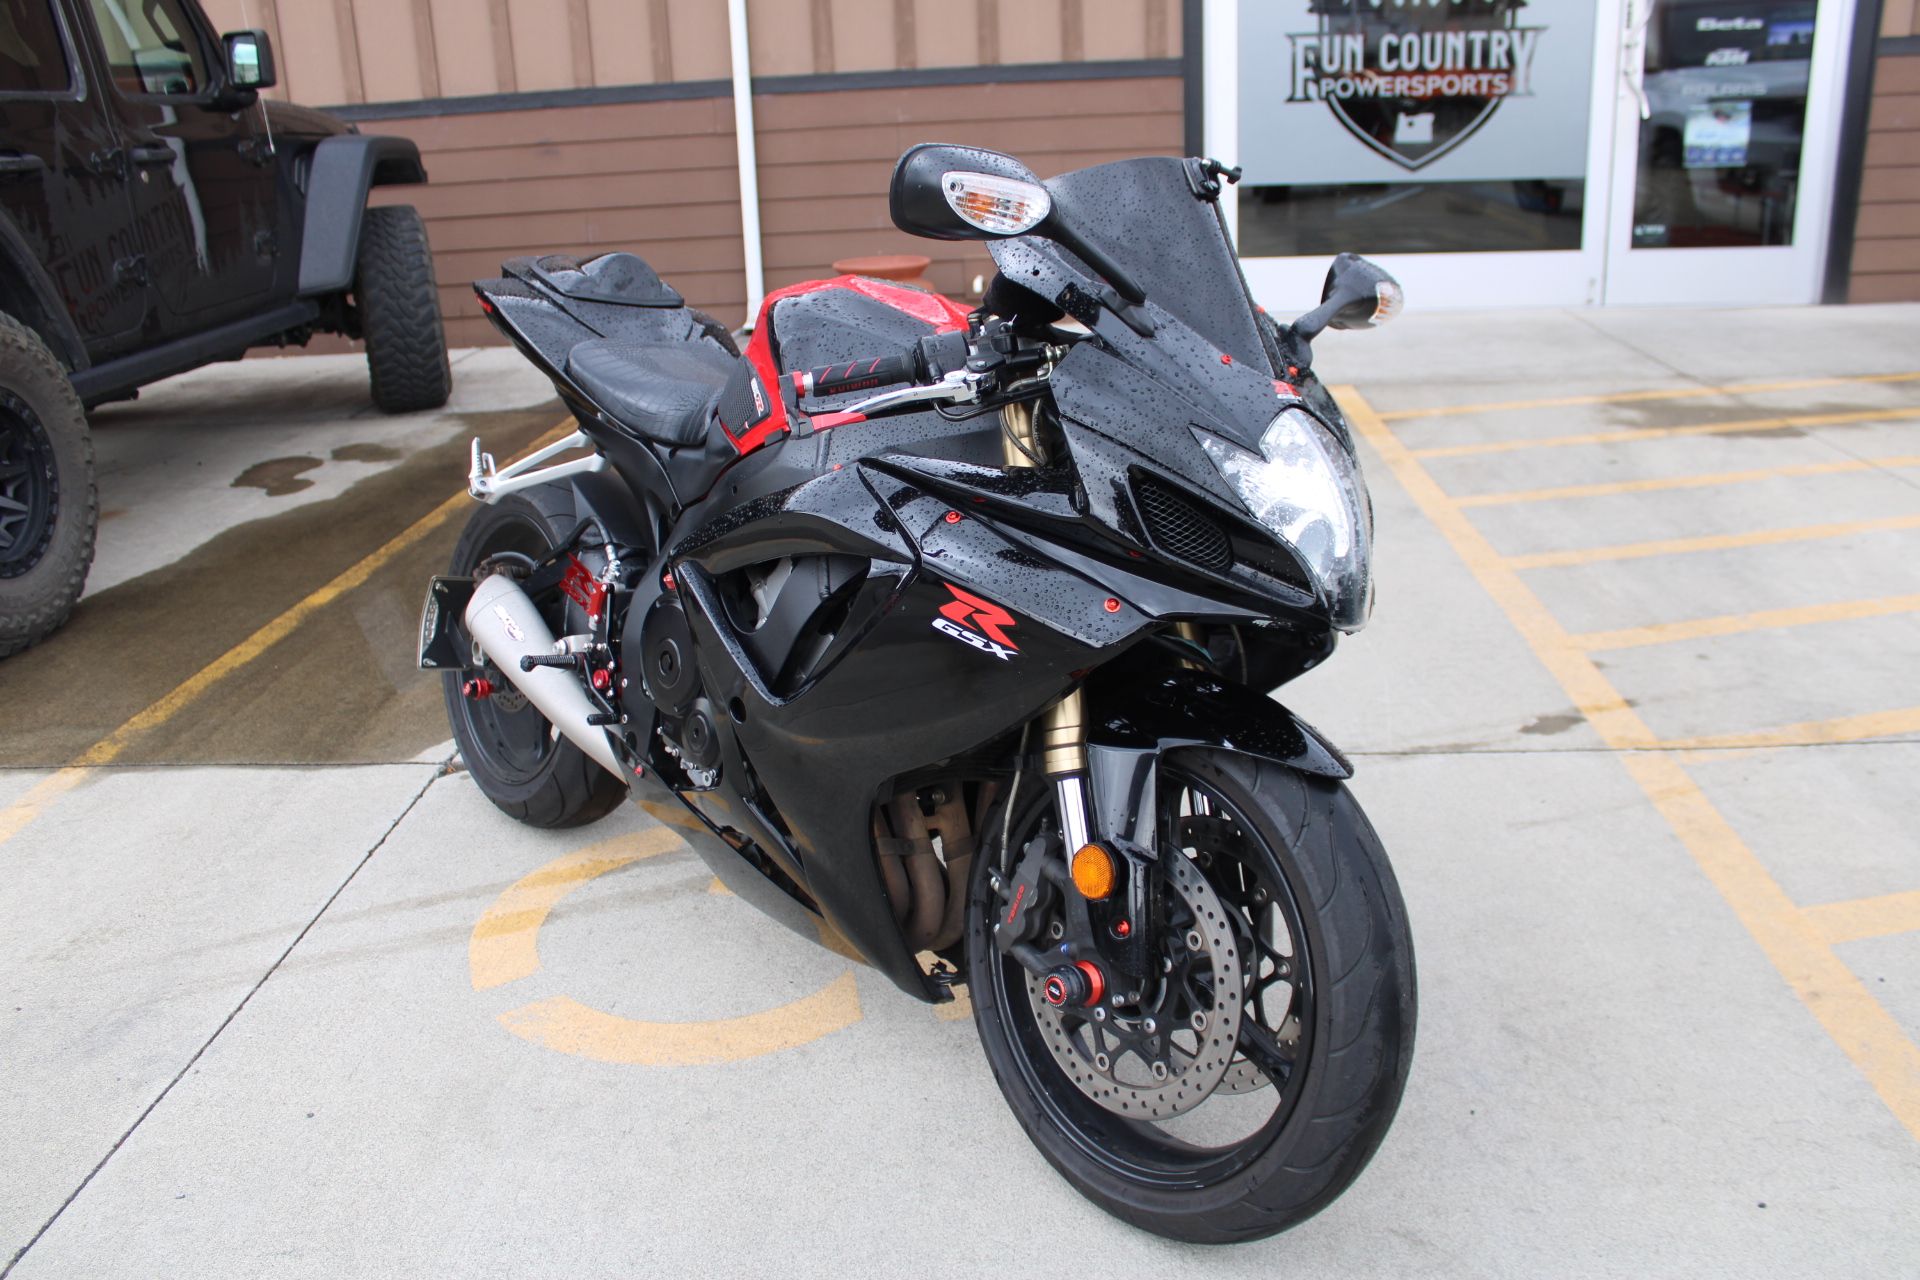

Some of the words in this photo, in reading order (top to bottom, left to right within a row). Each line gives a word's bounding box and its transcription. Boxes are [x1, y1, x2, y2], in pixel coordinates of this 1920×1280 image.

[1696, 16, 1764, 31] Beta
[1284, 33, 1364, 102] FUN
[1378, 25, 1549, 97] COUNTRY
[1705, 47, 1750, 67] KTM
[1319, 72, 1510, 99] POWERSPORTS
[931, 618, 1019, 661] GSX
